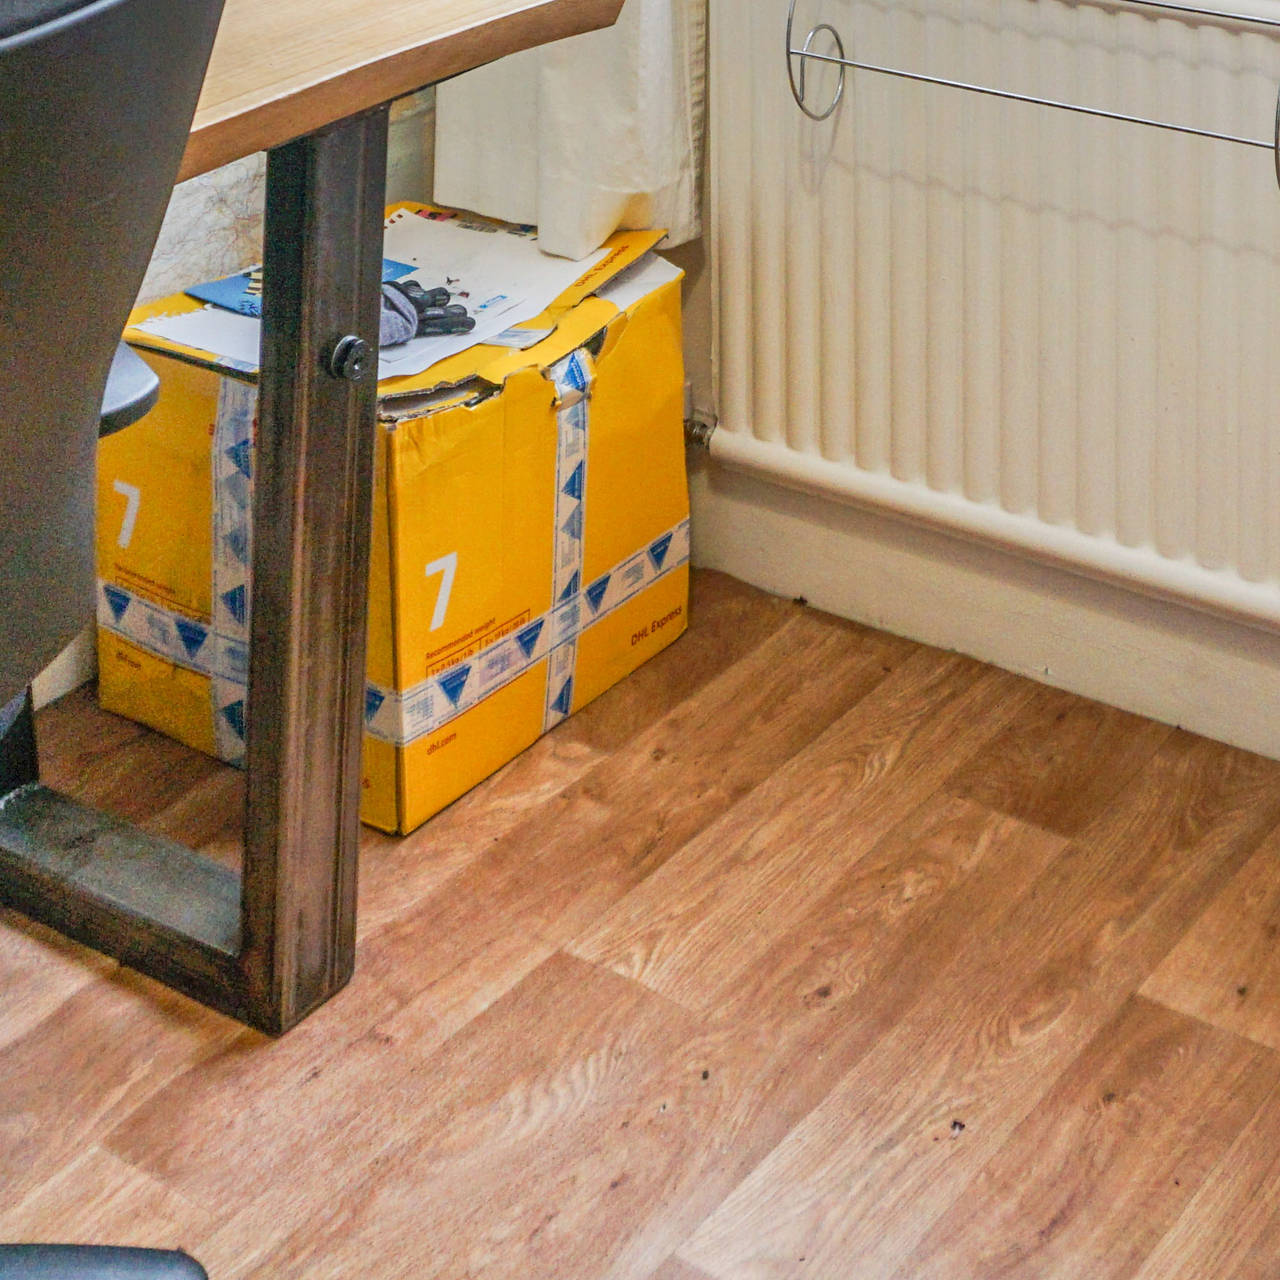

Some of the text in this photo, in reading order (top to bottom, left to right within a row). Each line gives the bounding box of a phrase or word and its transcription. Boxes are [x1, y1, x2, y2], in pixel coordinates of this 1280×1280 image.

[113, 478, 140, 549] 7
[424, 550, 458, 633] 7
[425, 628, 474, 660] Recommended
[474, 616, 496, 635] weight
[631, 604, 682, 647] DHL Express
[426, 732, 457, 756] dhl.com
